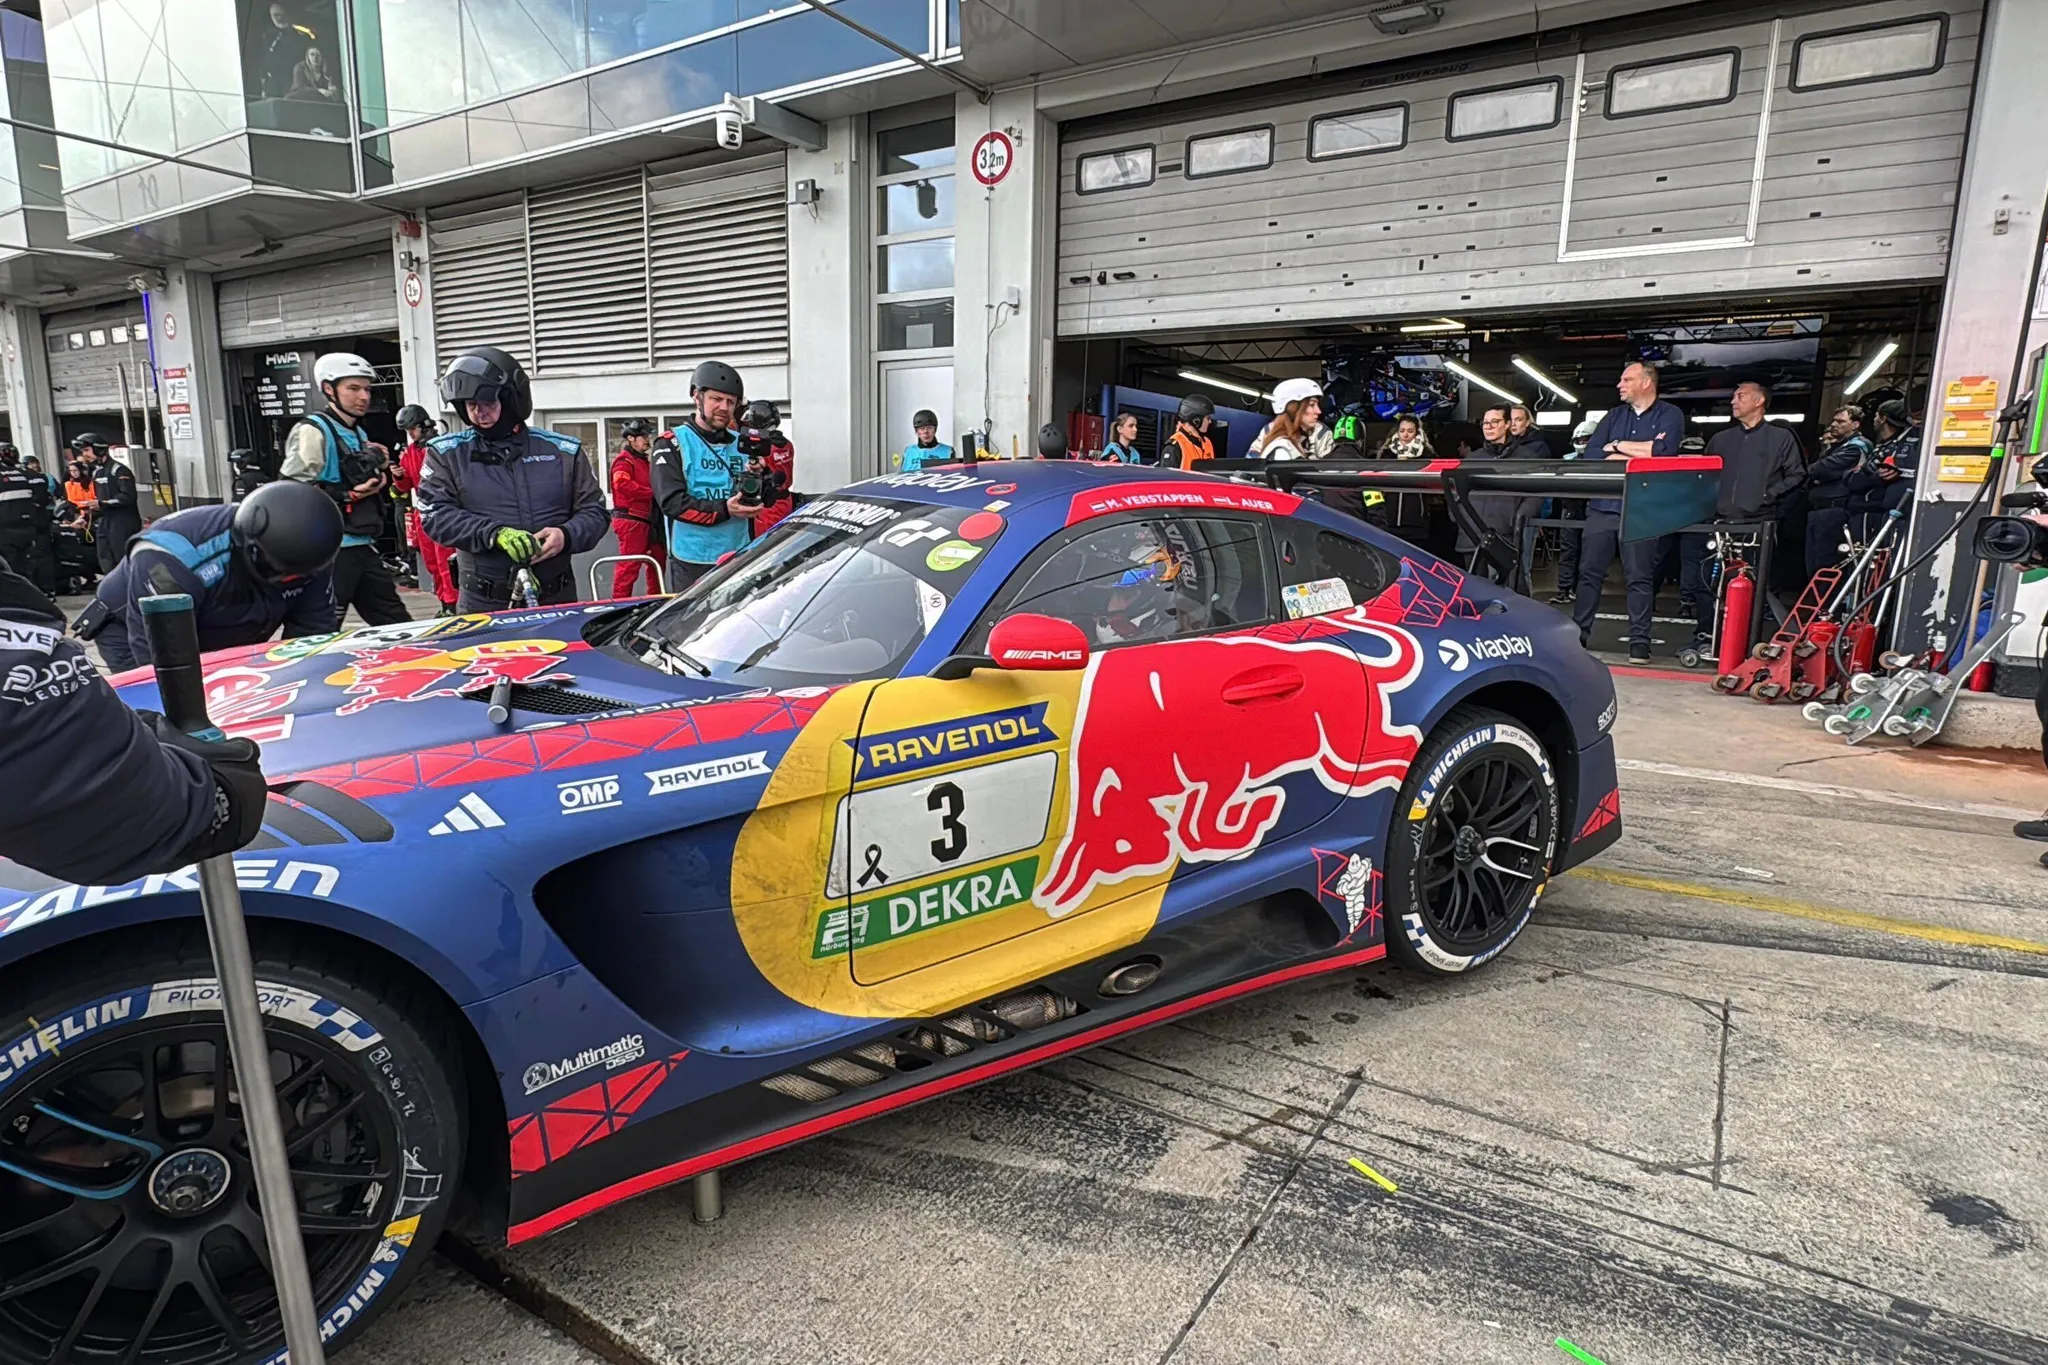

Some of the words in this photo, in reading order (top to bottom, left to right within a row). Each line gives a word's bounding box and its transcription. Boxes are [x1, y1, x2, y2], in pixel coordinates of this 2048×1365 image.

[266, 351, 301, 366] HWA
[1107, 498, 1123, 508] M.
[1125, 494, 1204, 506] VERSTAPPEN
[1226, 496, 1238, 506] L.
[1241, 499, 1273, 511] AUER
[1027, 650, 1082, 660] AMG
[1467, 633, 1533, 660] viaplay
[869, 715, 1040, 768] RAVENOL
[658, 758, 760, 788] RAVENOL
[1428, 727, 1492, 790] MICHELIN
[559, 780, 620, 809] OMP
[926, 780, 968, 863] 3
[889, 867, 1022, 935] DEKRA
[256, 991, 296, 1009] ORT
[551, 1033, 643, 1079] Multimatic
[606, 1048, 645, 1070] DSSV
